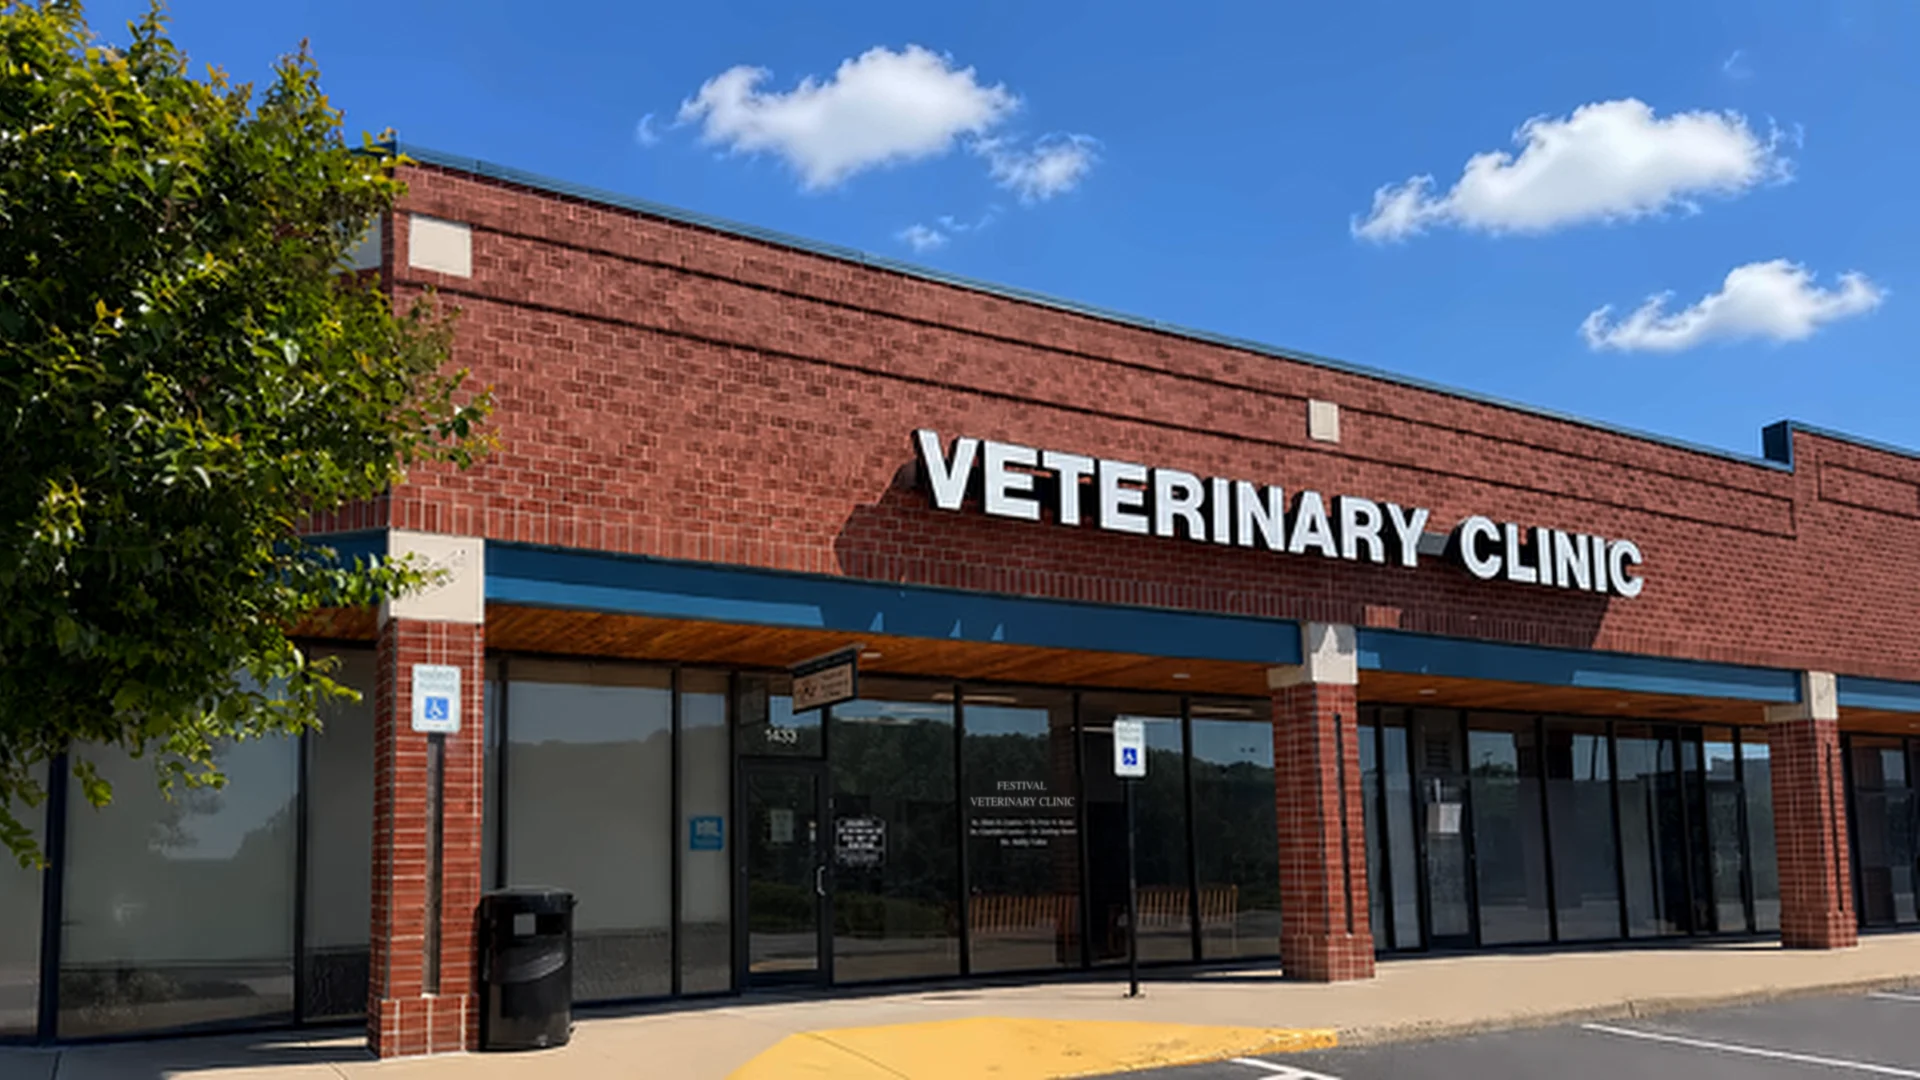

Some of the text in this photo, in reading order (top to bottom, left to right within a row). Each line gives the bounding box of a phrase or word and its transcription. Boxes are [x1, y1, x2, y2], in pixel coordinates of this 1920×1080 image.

[917, 429, 1644, 599] VETERINARY CLINIC
[997, 781, 1047, 791] FESTIVAL
[970, 796, 1075, 807] VETERINARY CLINIC
